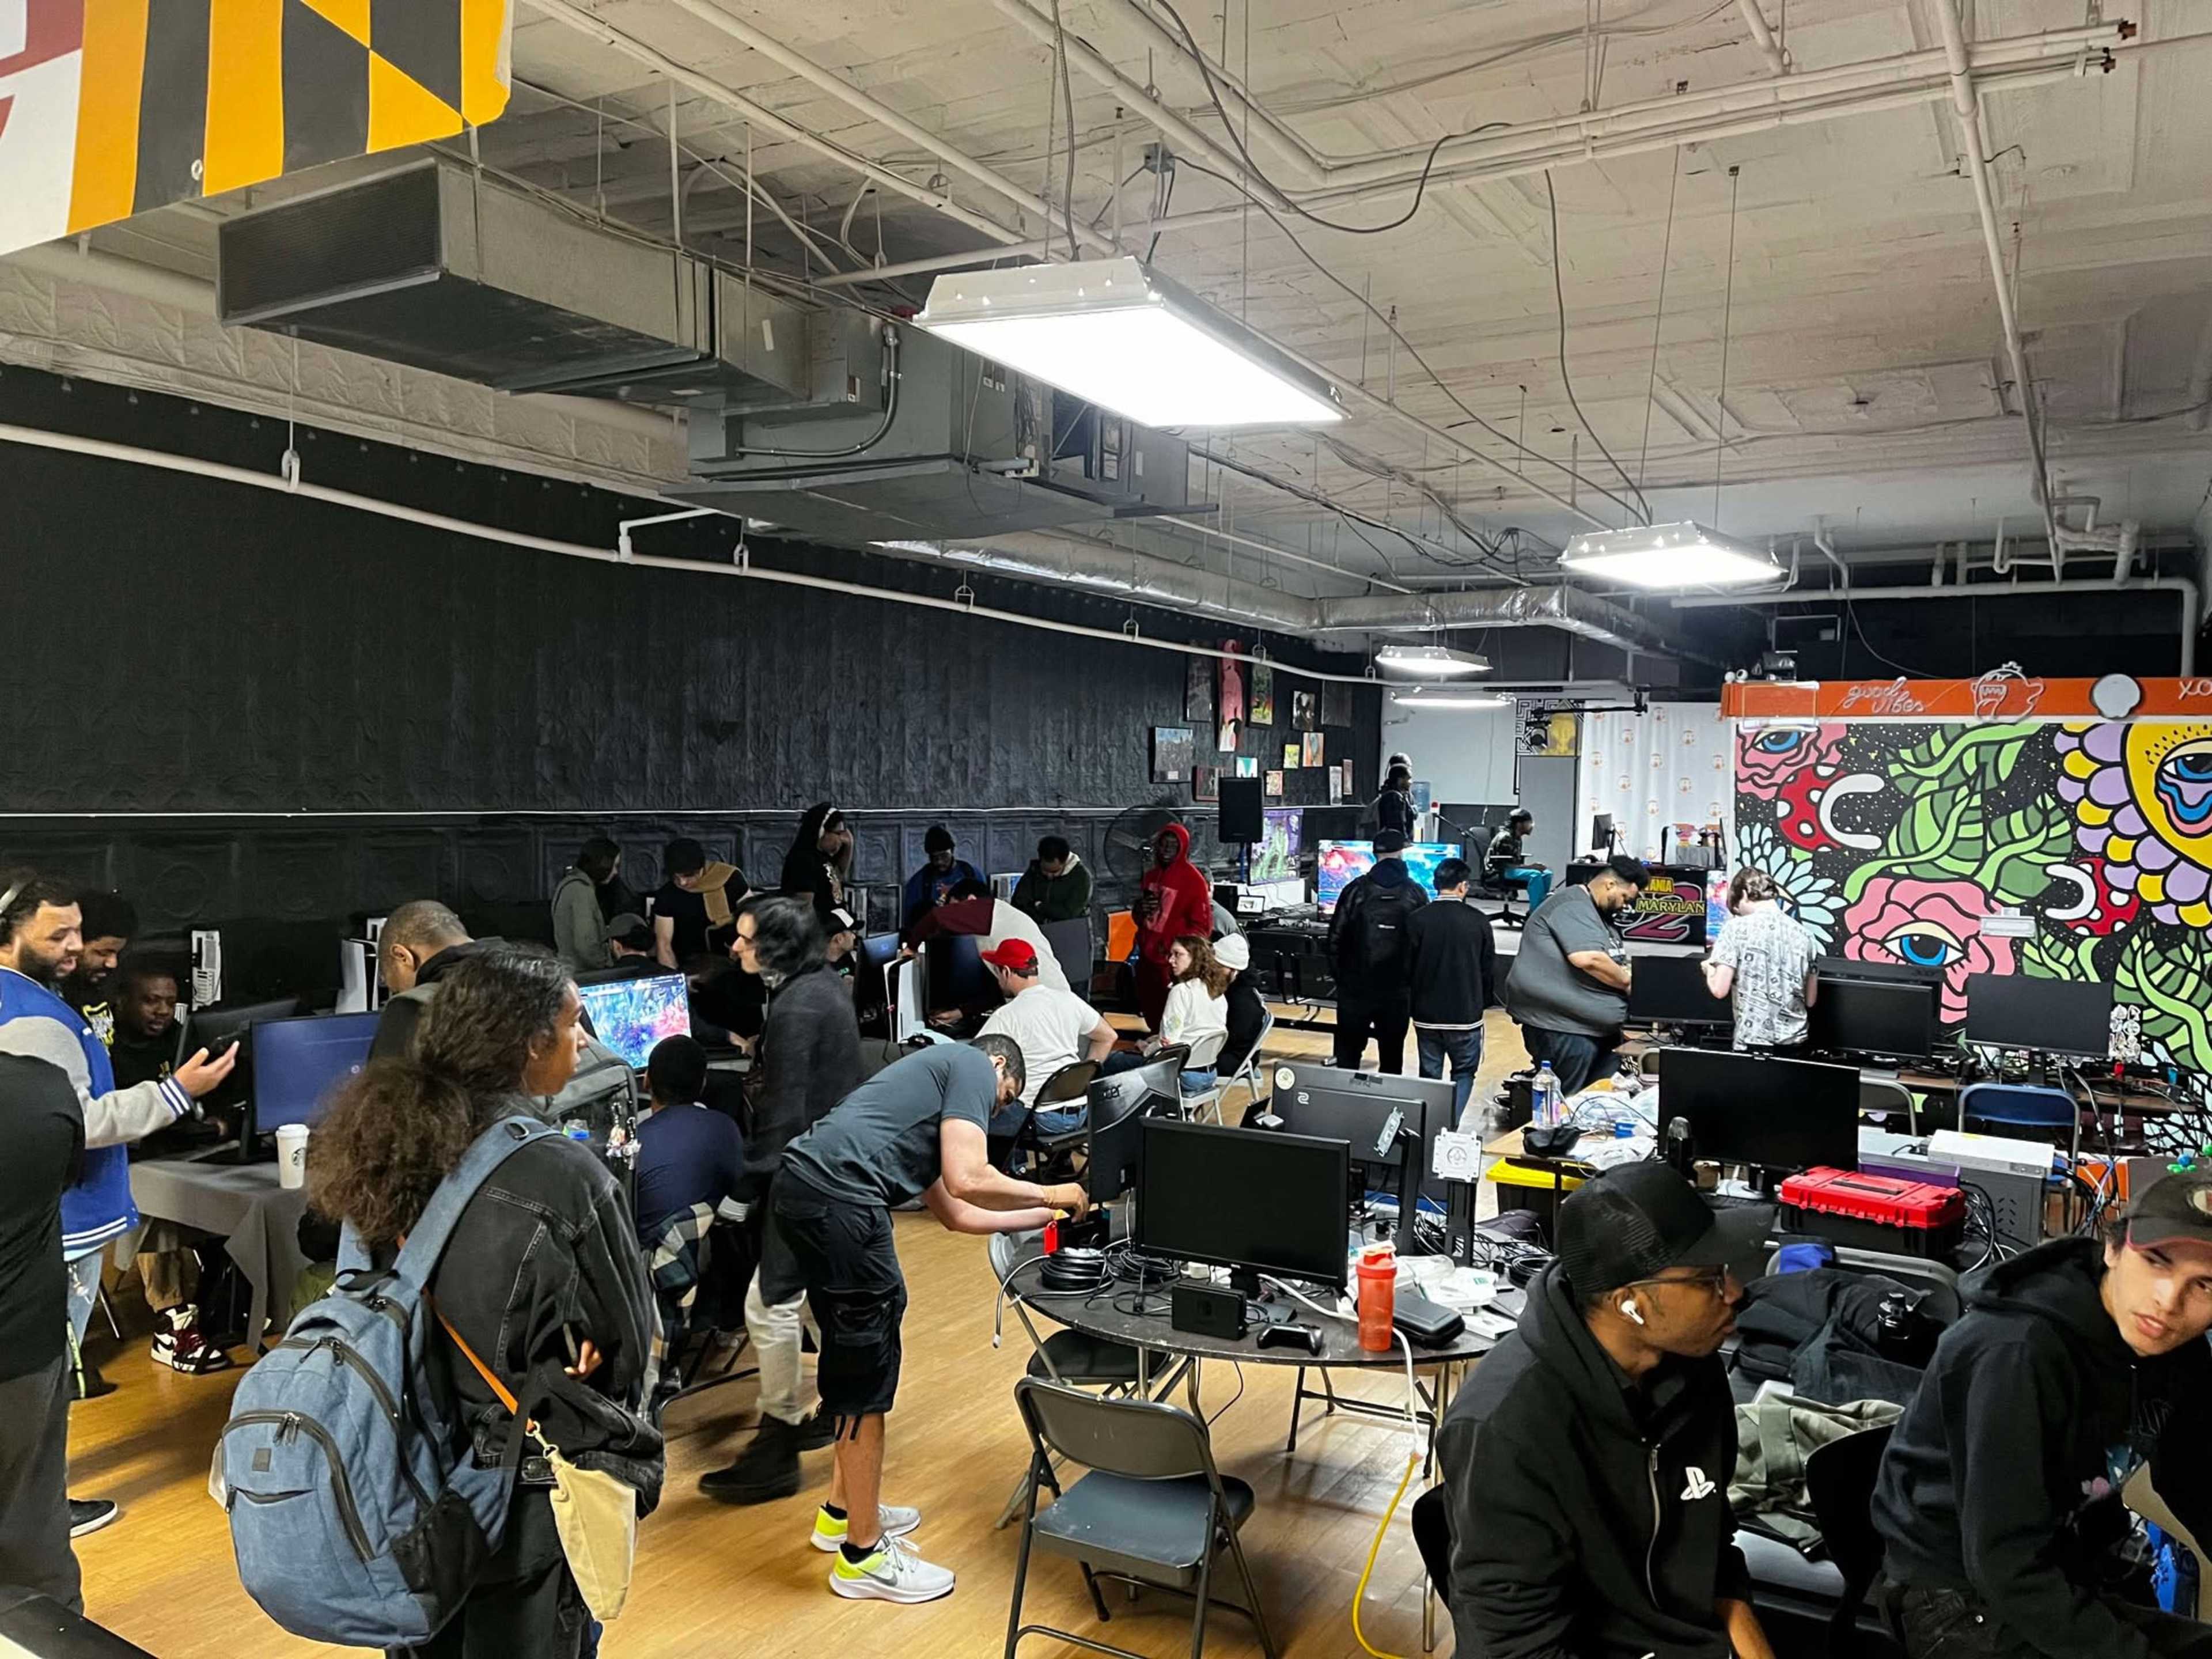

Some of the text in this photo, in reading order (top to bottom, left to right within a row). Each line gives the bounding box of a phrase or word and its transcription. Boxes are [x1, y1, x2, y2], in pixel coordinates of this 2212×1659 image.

[1843, 676, 1907, 709] good
[1871, 691, 1925, 714] vibes
[1645, 878, 1672, 892] ANIA
